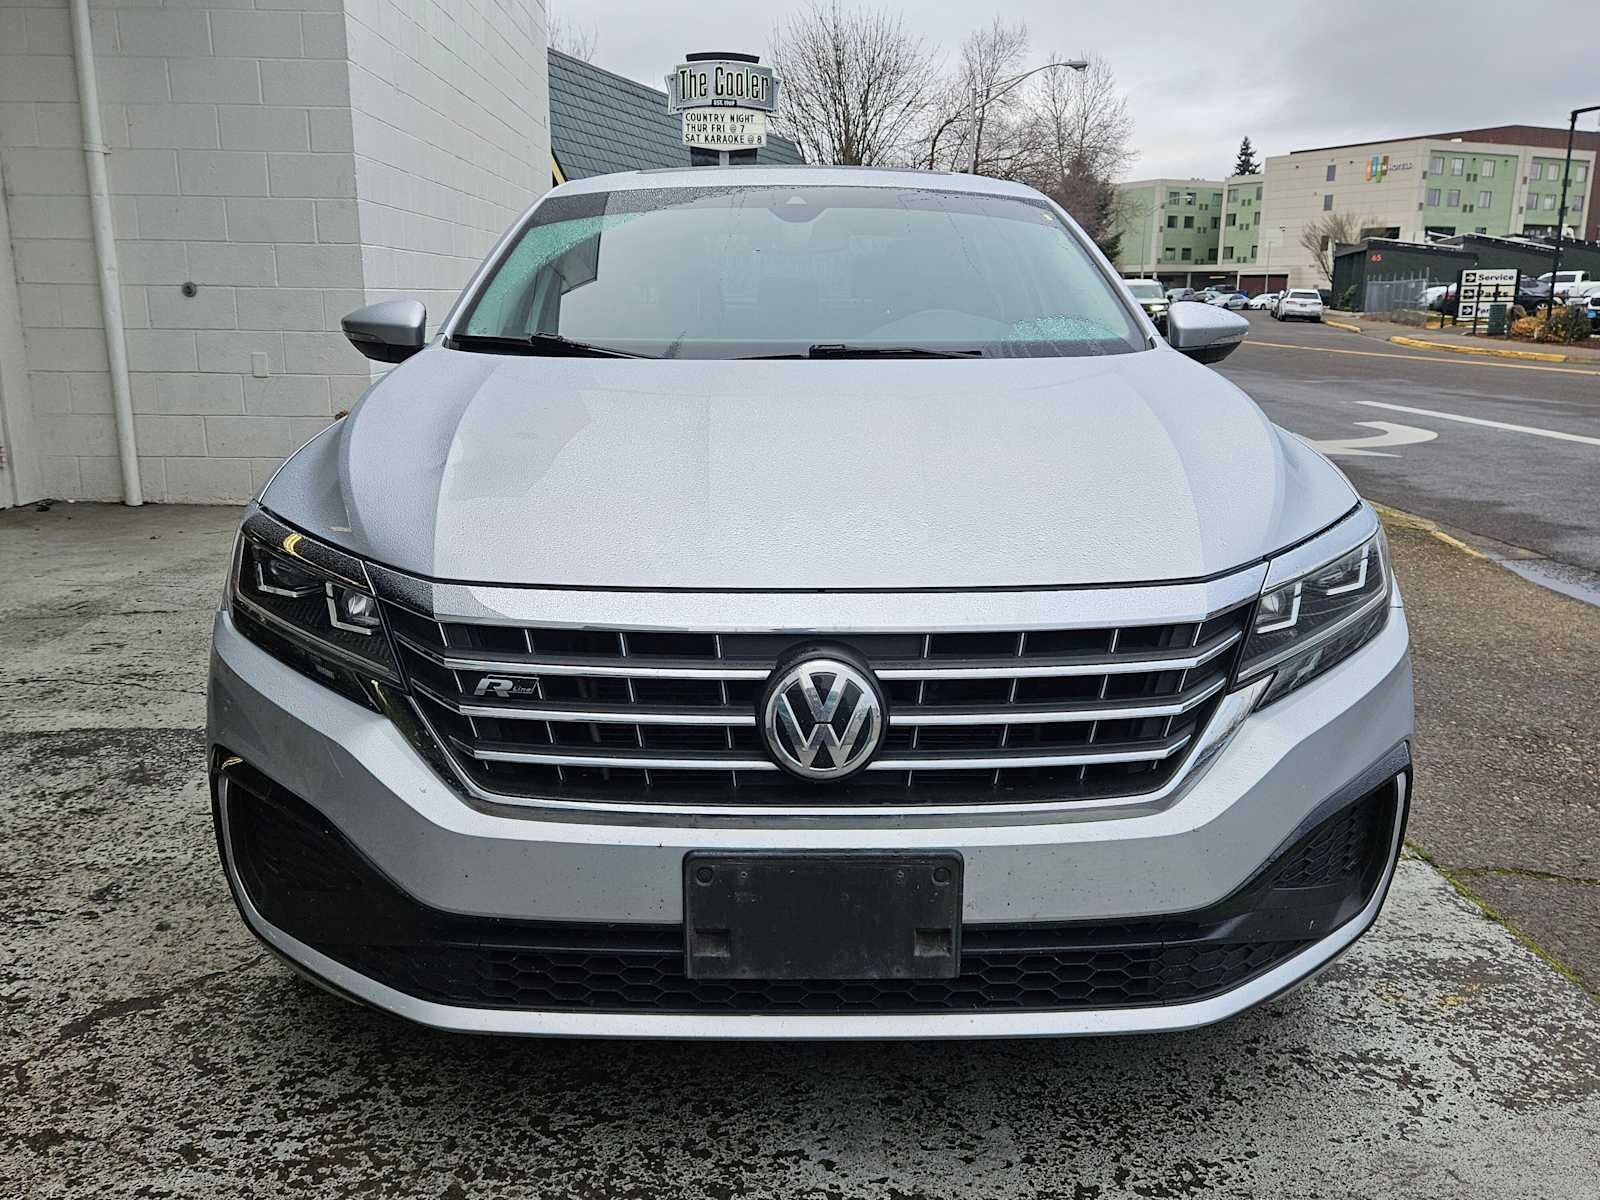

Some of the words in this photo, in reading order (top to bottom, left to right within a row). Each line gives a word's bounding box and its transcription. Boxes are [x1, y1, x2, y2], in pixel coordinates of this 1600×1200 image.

[680, 67, 708, 100] The
[715, 65, 769, 100] Cooler
[685, 112, 726, 122] COUNTRY
[730, 113, 755, 123] NIGHT
[686, 123, 708, 133] THUR
[711, 123, 726, 133] FRI
[740, 124, 745, 133] 7
[685, 133, 701, 143] SAT
[704, 134, 745, 144] KARAOKE
